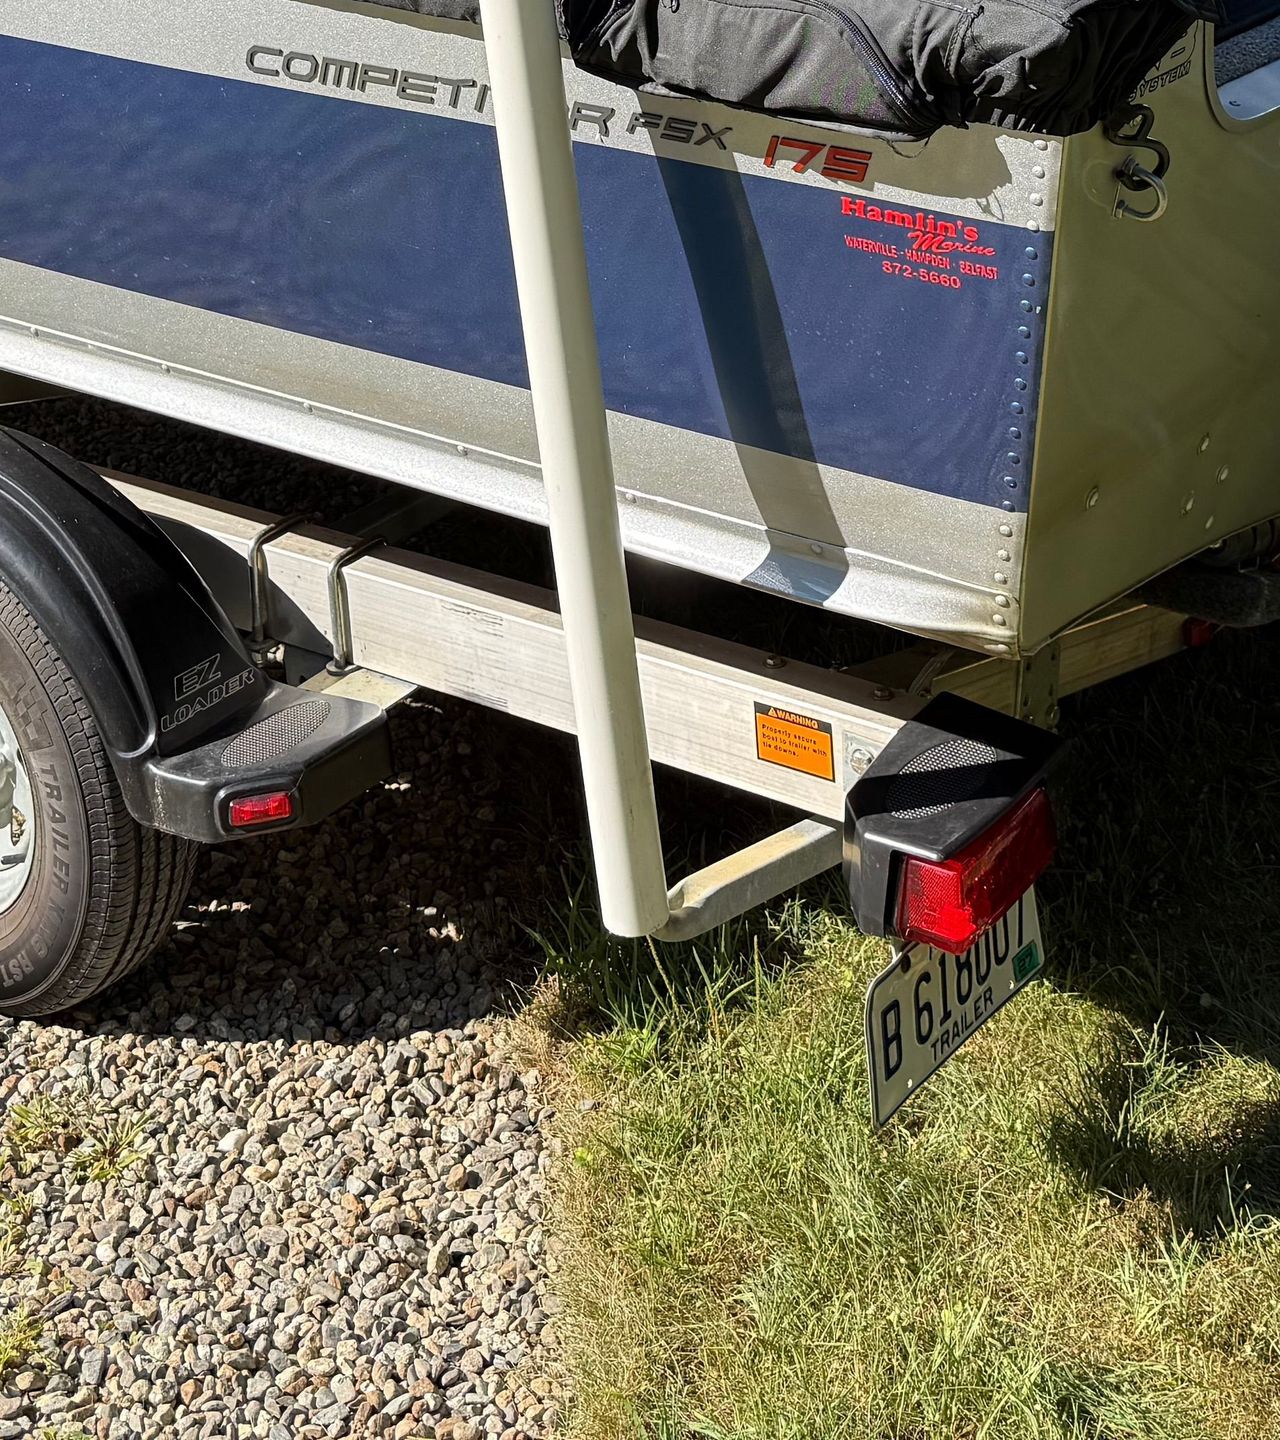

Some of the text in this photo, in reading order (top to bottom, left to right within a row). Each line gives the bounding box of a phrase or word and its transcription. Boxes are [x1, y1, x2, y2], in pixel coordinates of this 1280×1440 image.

[245, 44, 875, 182] COMPETIR FSX 175
[840, 196, 980, 242] Hamlin's
[844, 234, 999, 280] WATERVILLE HAMPDEN BELFAST
[907, 231, 996, 257] Marine
[882, 260, 962, 290] 872-5660
[160, 667, 255, 733] LOADER
[173, 652, 221, 702] EZ
[761, 723, 817, 745] Properly secure
[776, 709, 819, 729] WARNING
[762, 733, 827, 757] boat to trailer with
[762, 741, 772, 749] tie
[40, 763, 70, 896] TRAILER
[1, 948, 36, 988] RST
[881, 999, 902, 1082] B
[930, 985, 994, 1063] TRAILER
